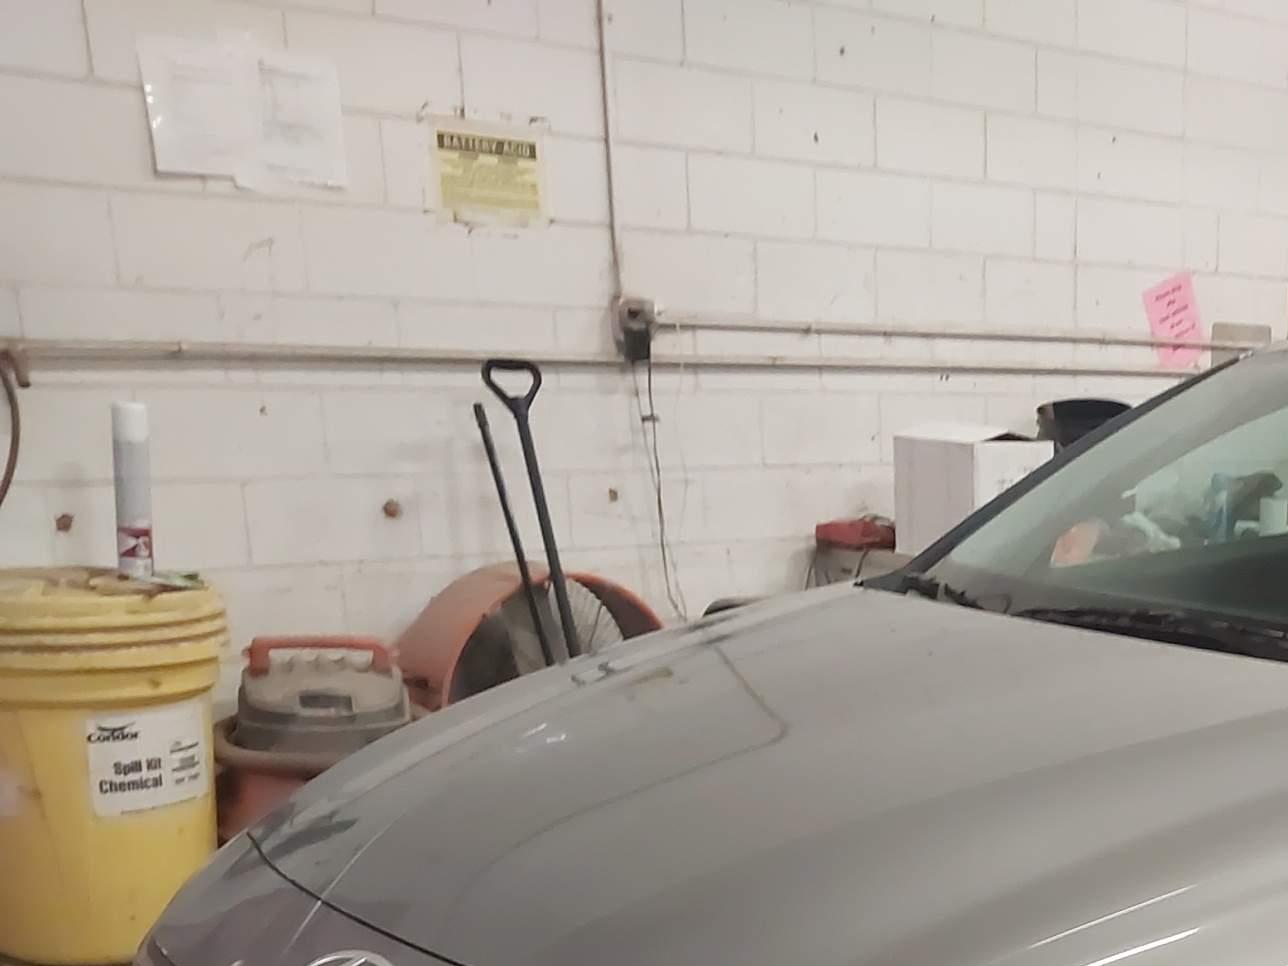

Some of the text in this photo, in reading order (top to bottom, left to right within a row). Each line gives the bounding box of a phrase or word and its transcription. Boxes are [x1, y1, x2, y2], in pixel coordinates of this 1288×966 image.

[86, 728, 141, 745] Condor
[112, 759, 142, 777] Spill
[145, 757, 162, 772] Kit
[98, 774, 163, 795] Chemical
